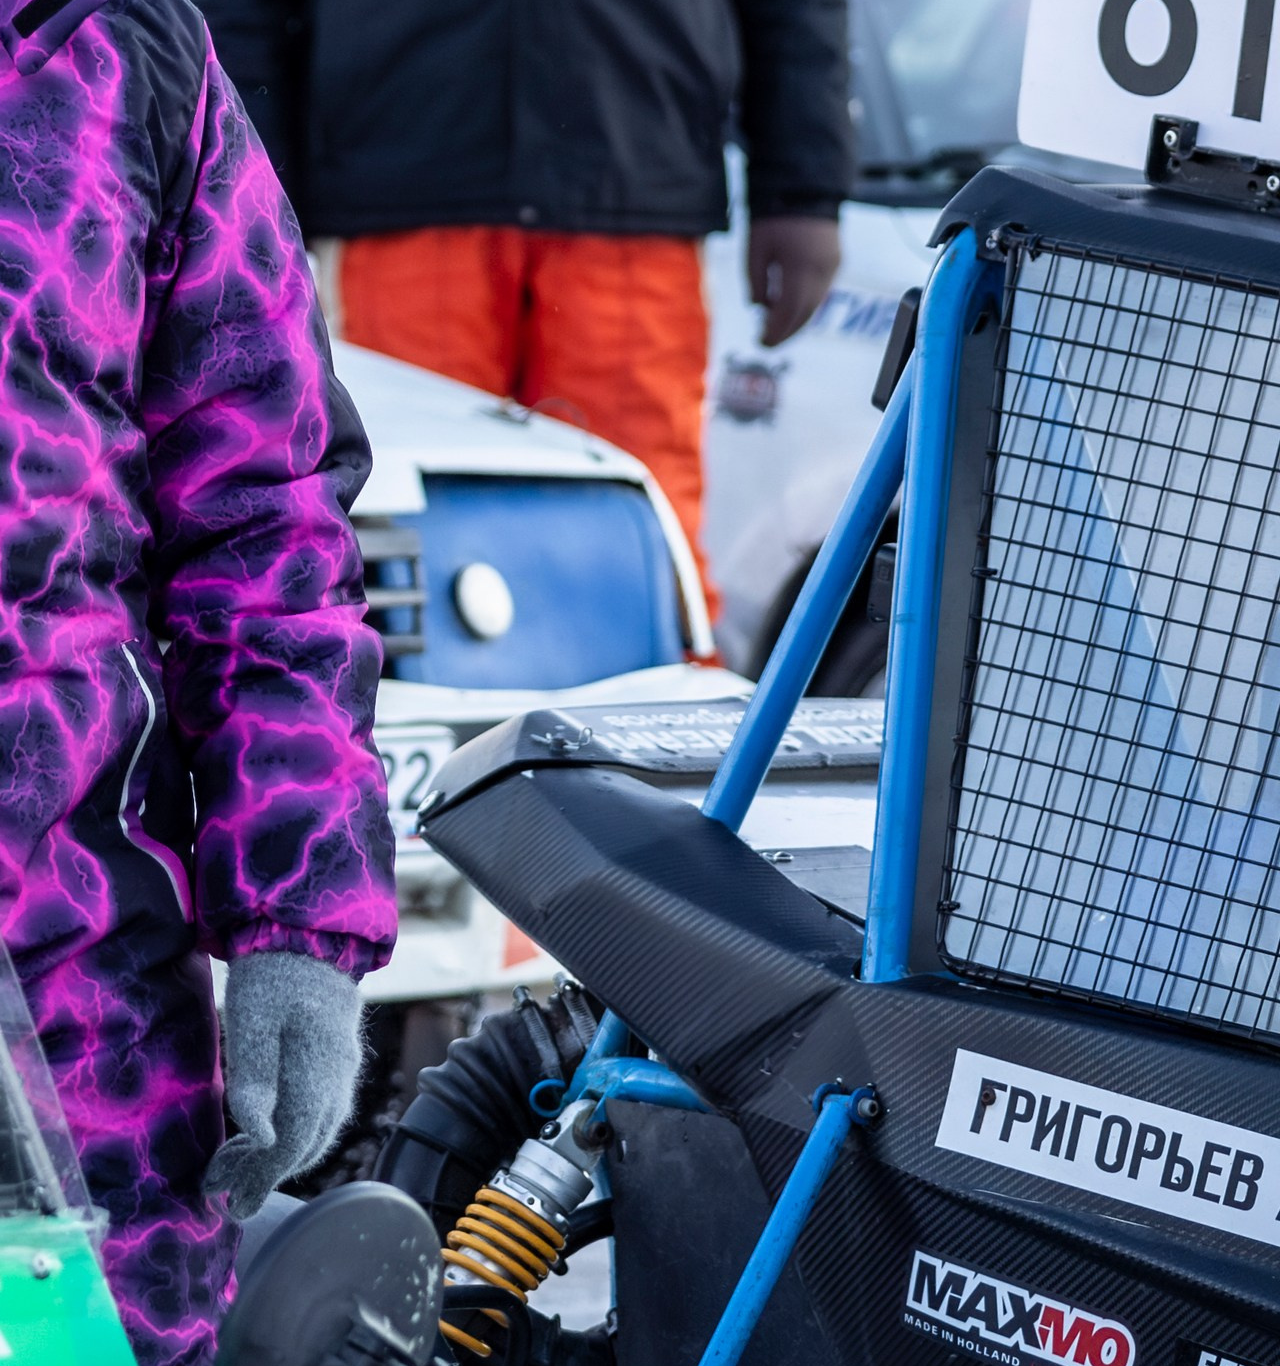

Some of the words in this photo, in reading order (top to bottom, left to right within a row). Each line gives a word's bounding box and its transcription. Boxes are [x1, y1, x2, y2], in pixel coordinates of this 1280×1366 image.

[970, 1077, 1264, 1211] ГРИГОРЬЕВ
[904, 1313, 938, 1335] MADE
[941, 1329, 954, 1343] IN
[957, 1337, 1020, 1366] HOLLAND
